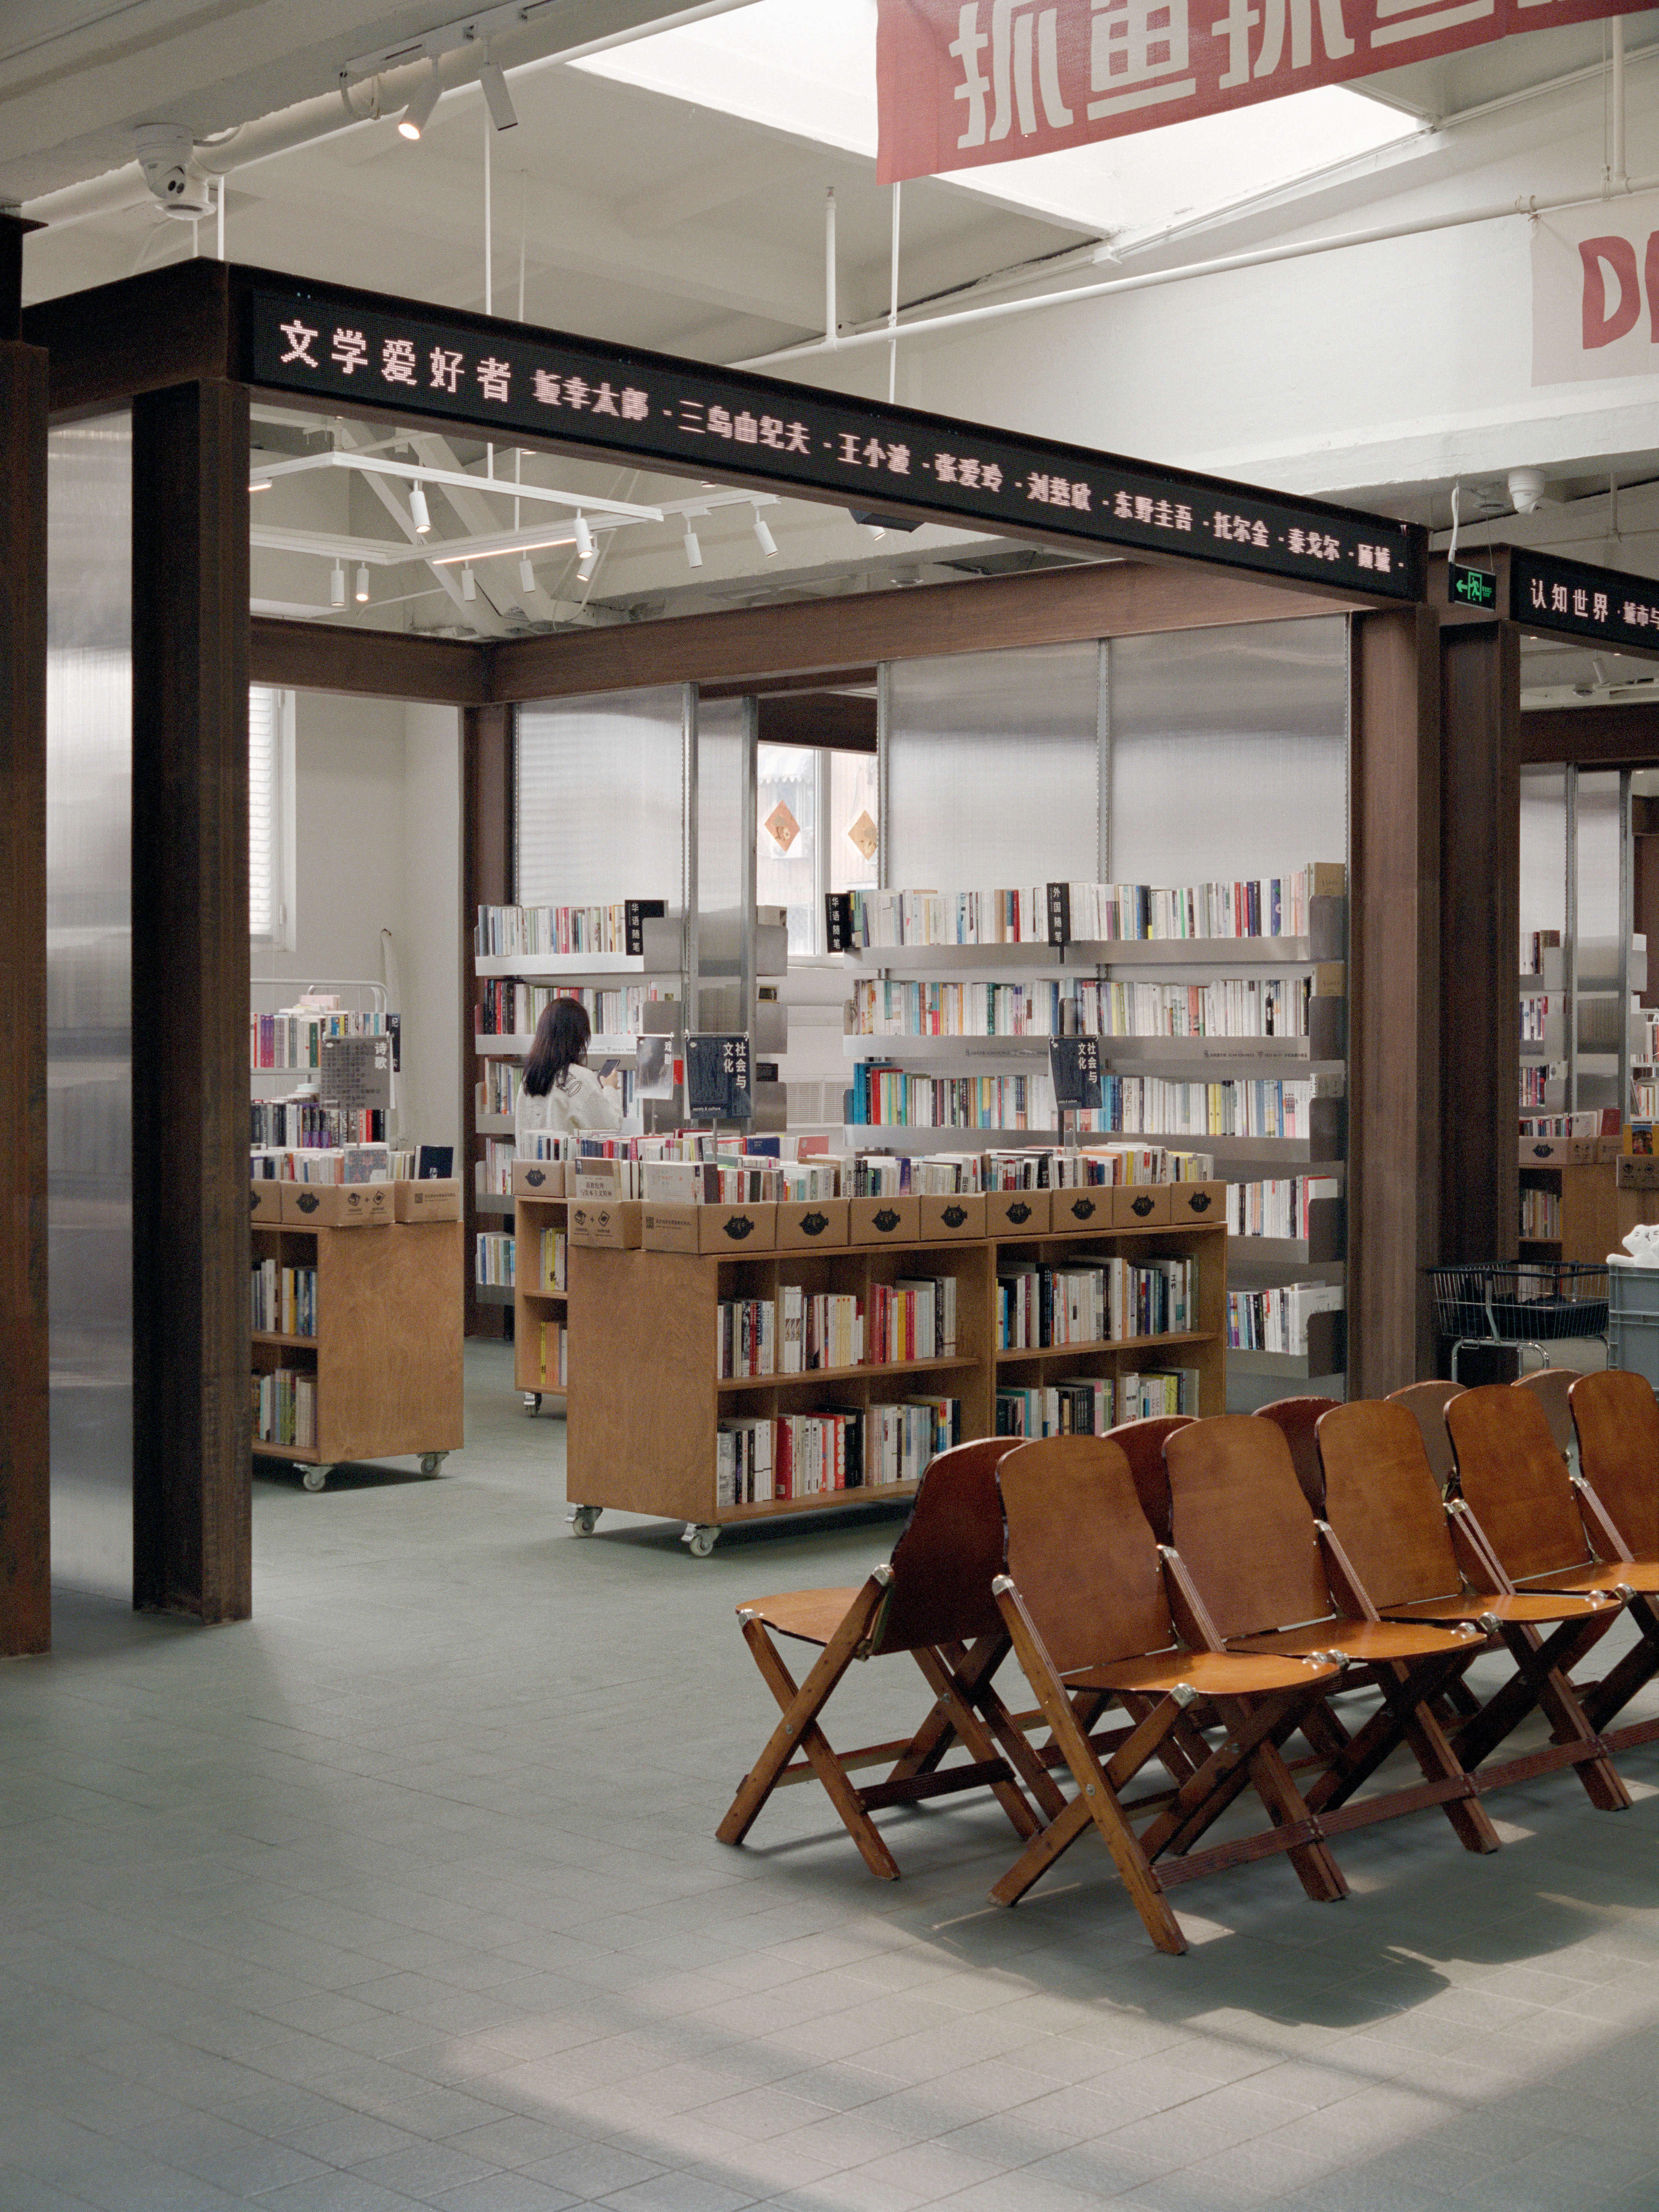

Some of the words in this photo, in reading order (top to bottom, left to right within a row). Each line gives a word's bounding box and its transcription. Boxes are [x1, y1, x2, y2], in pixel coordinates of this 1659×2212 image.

[949, 0, 1553, 149] 抓鱼抓
[1578, 231, 1659, 350] D
[279, 320, 511, 402] 文学爱好者
[1530, 578, 1609, 623] 认知世界
[631, 903, 640, 952] 华语随笔
[832, 897, 840, 949] 华语随笔
[1053, 887, 1062, 942] 外国随笔
[374, 1042, 387, 1070] 诗歌
[664, 1041, 672, 1065] 戏剧
[723, 1042, 733, 1073] 文化
[735, 1042, 747, 1089] 社会与
[1078, 1042, 1087, 1070] 文化
[1087, 1042, 1097, 1083] 社会与
